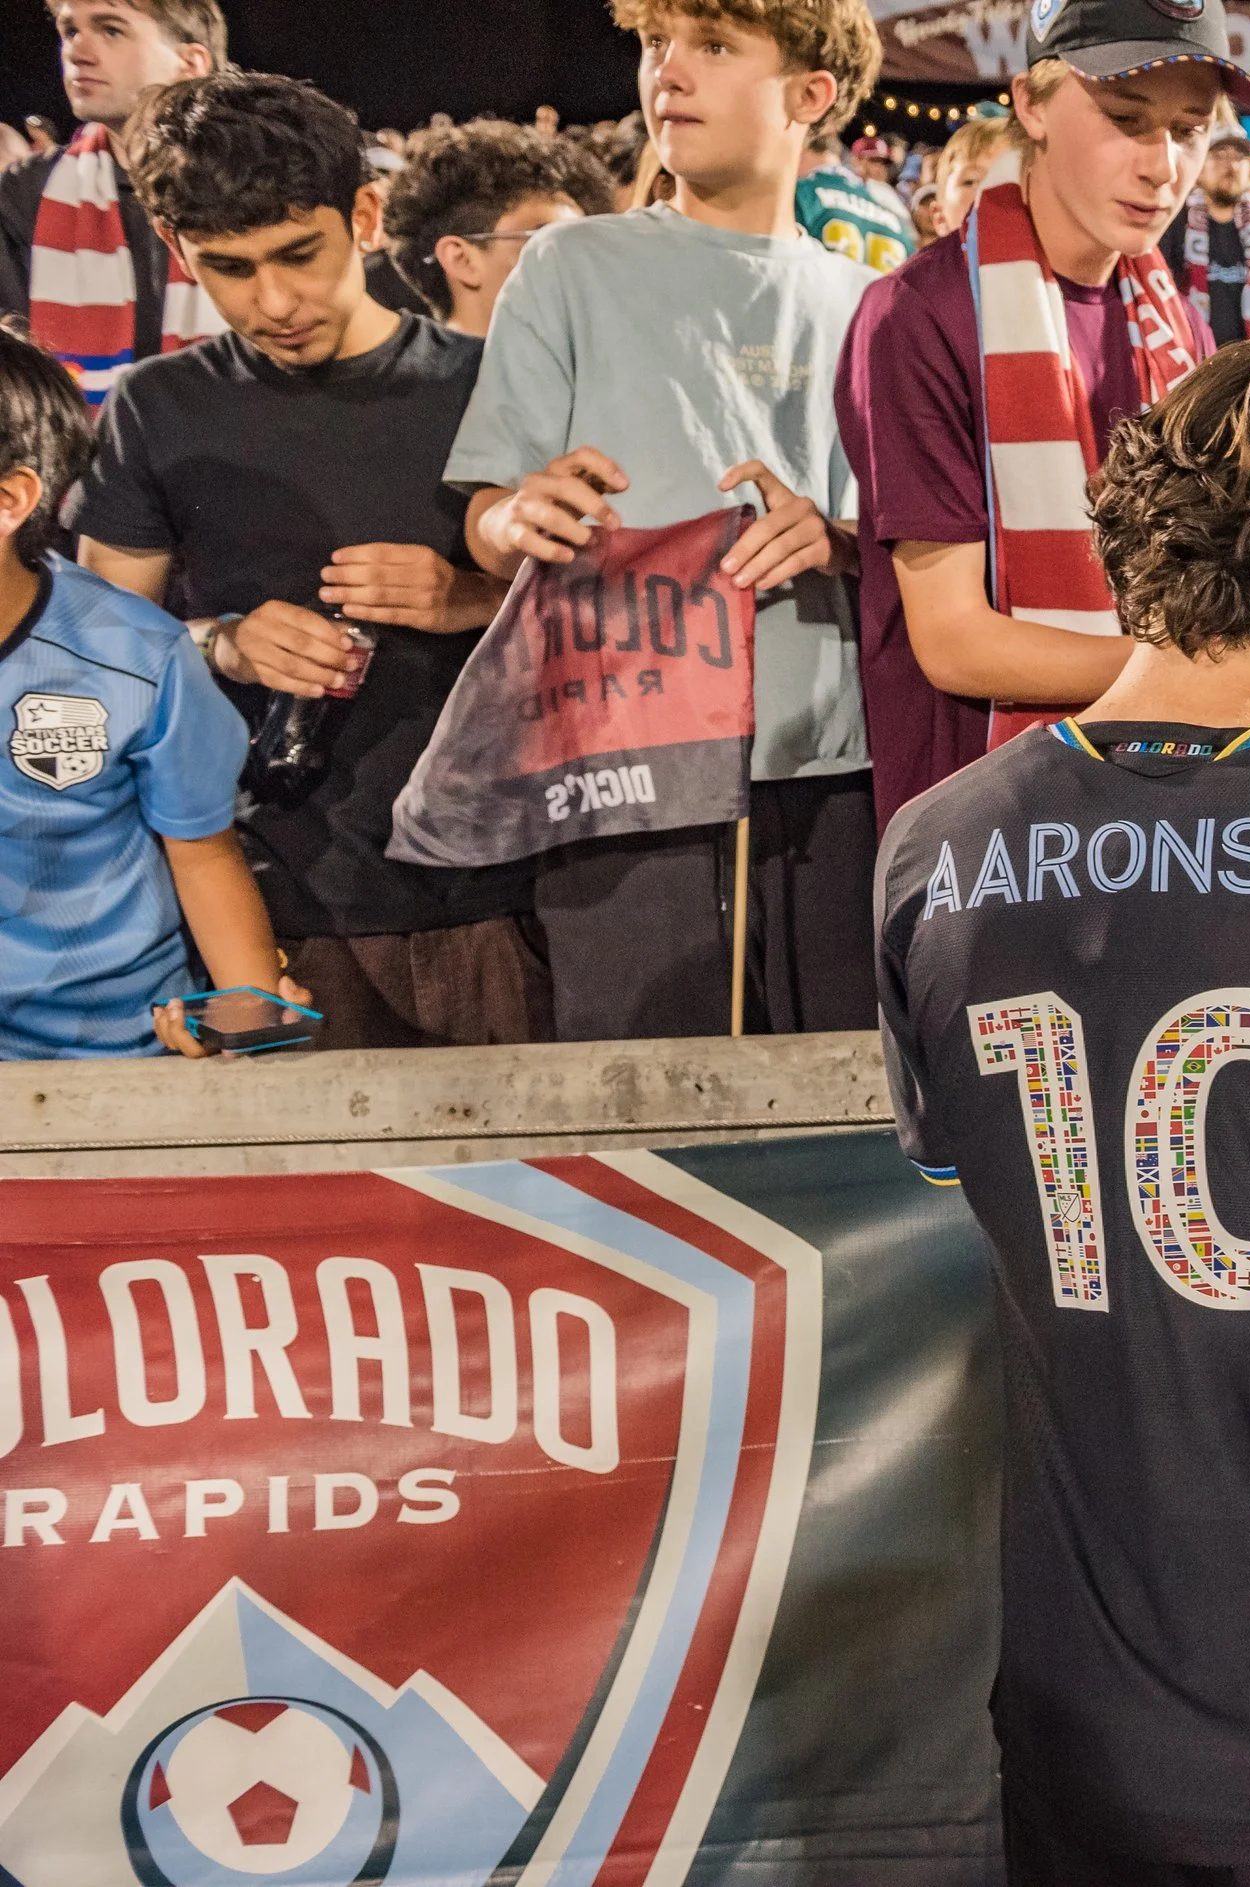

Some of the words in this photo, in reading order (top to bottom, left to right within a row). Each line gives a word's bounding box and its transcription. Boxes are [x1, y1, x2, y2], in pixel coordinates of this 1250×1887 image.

[10, 735, 109, 755] SOCCER
[1115, 741, 1212, 757] COLORADO
[0, 1254, 620, 1474] LORADO
[3, 1468, 461, 1548] RAPIDS
